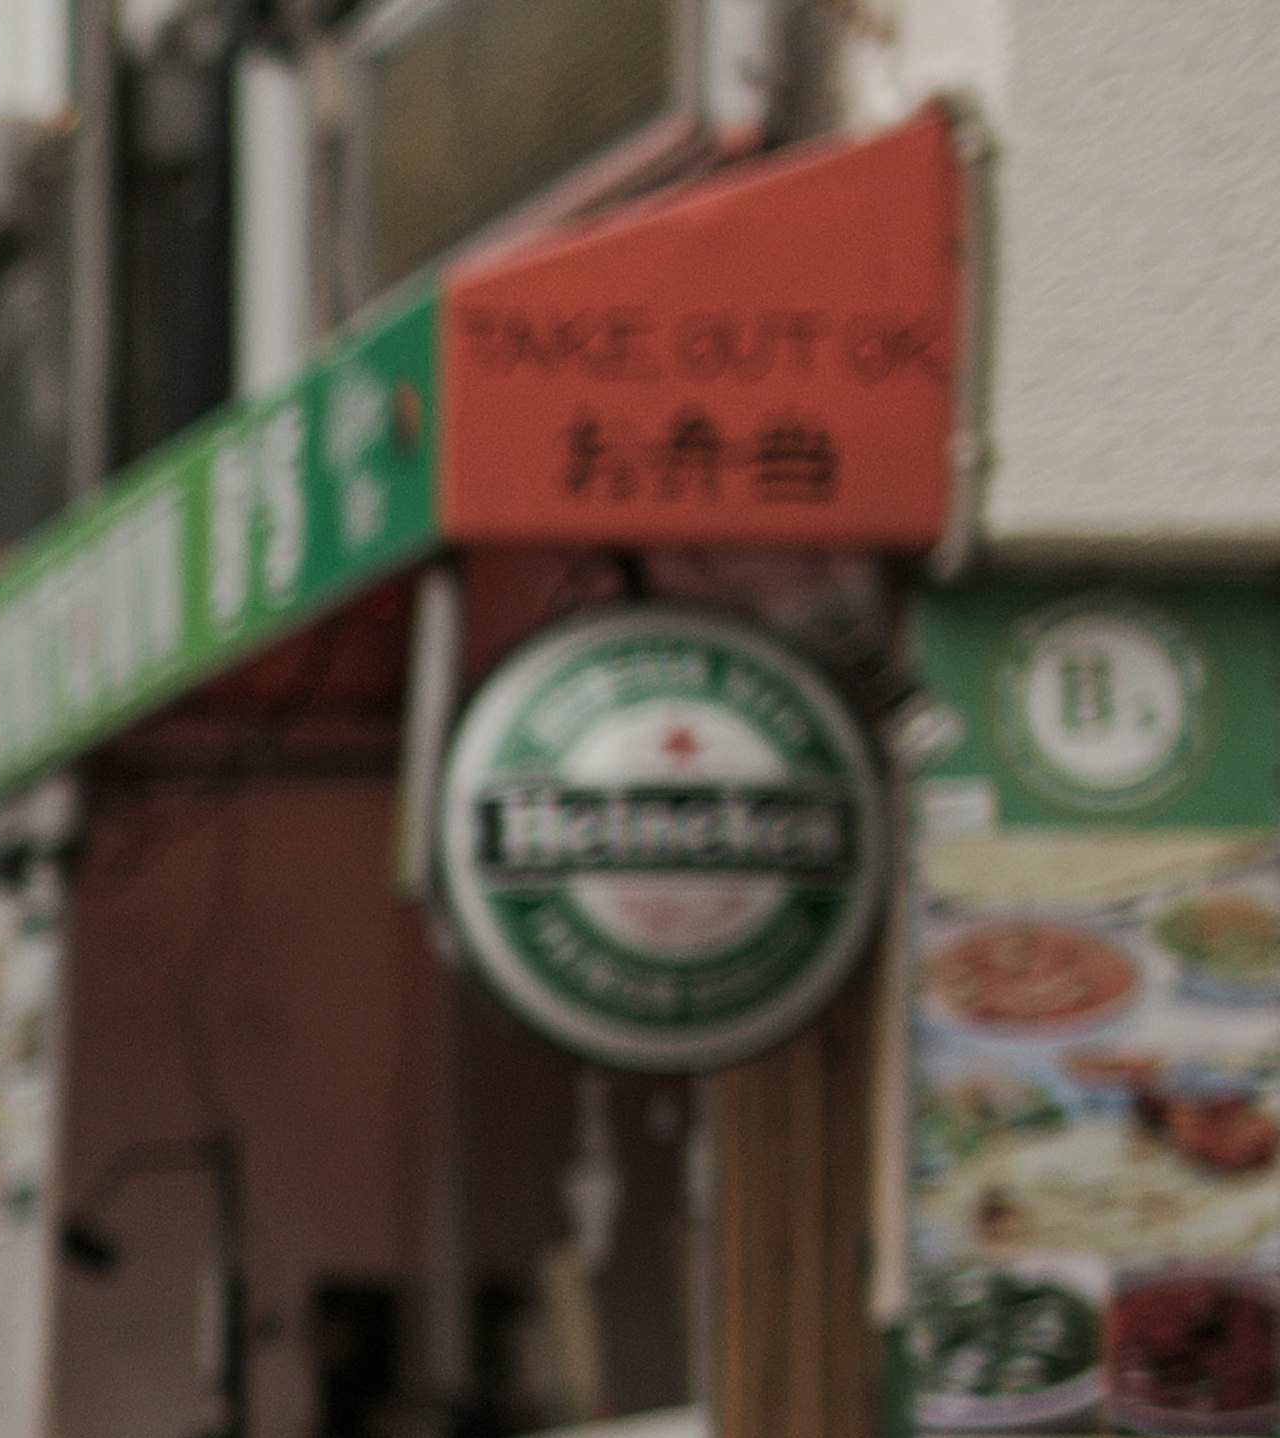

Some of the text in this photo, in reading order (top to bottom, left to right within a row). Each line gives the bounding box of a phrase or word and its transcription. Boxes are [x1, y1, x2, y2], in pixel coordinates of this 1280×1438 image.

[456, 306, 950, 386] TAKE OUT OK
[562, 403, 839, 504] お弁当
[500, 792, 840, 867] Heineken
